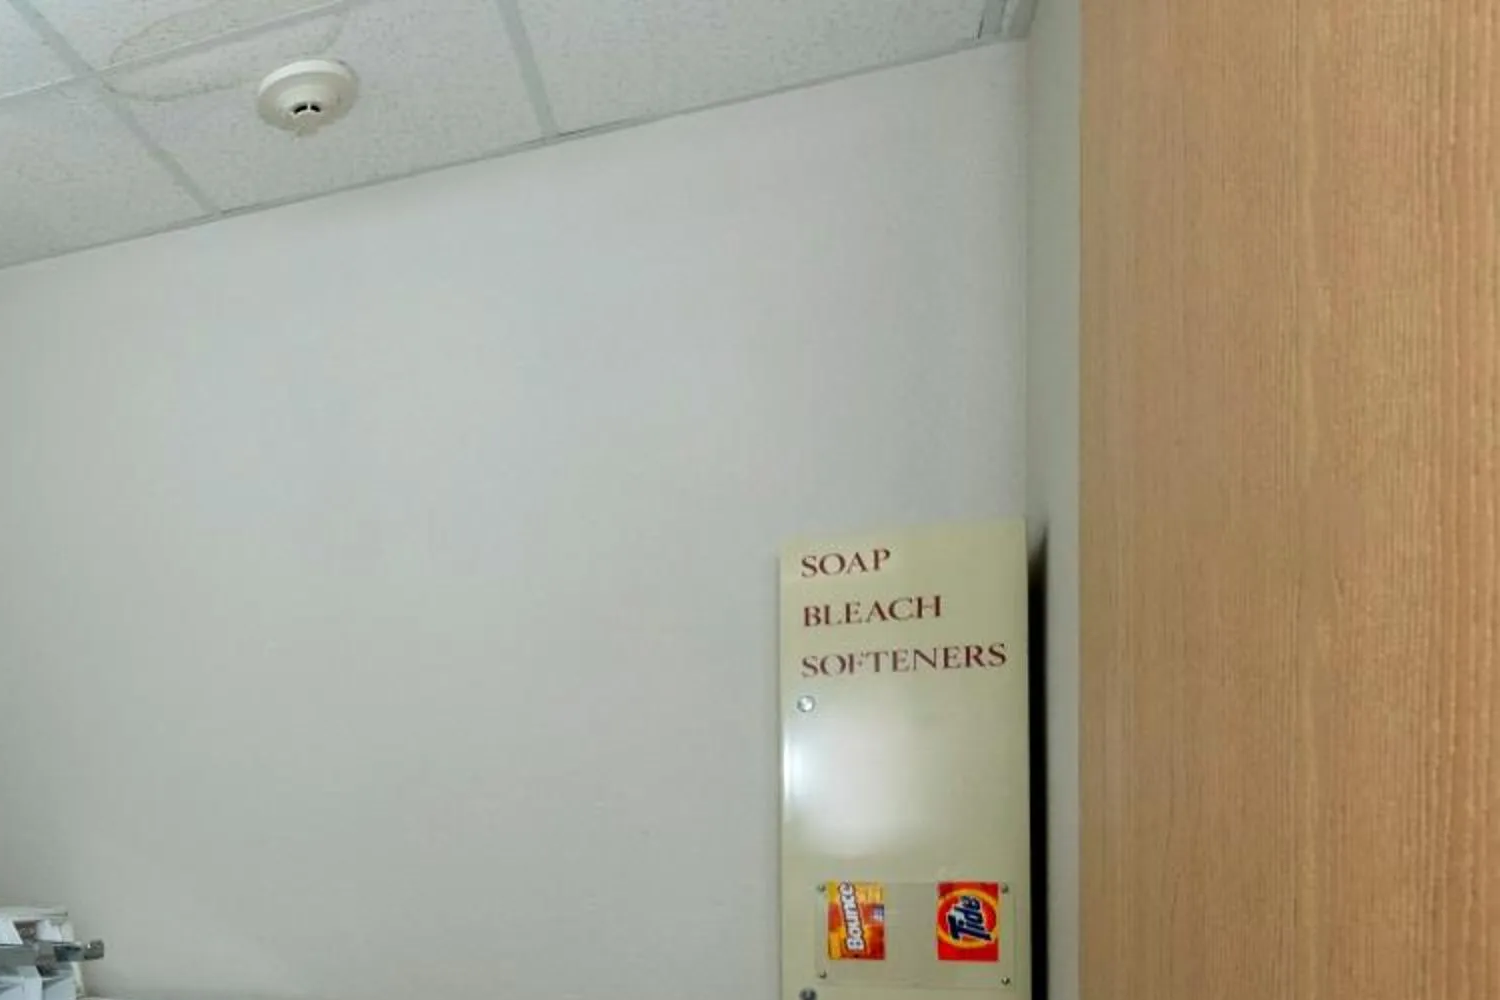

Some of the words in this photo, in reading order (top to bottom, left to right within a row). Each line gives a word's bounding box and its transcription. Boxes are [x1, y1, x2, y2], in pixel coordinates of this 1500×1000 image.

[801, 548, 891, 579] SOAP
[803, 595, 942, 627] BLEACH
[801, 642, 1008, 678] SOFTENERS
[946, 895, 993, 941] Tide
